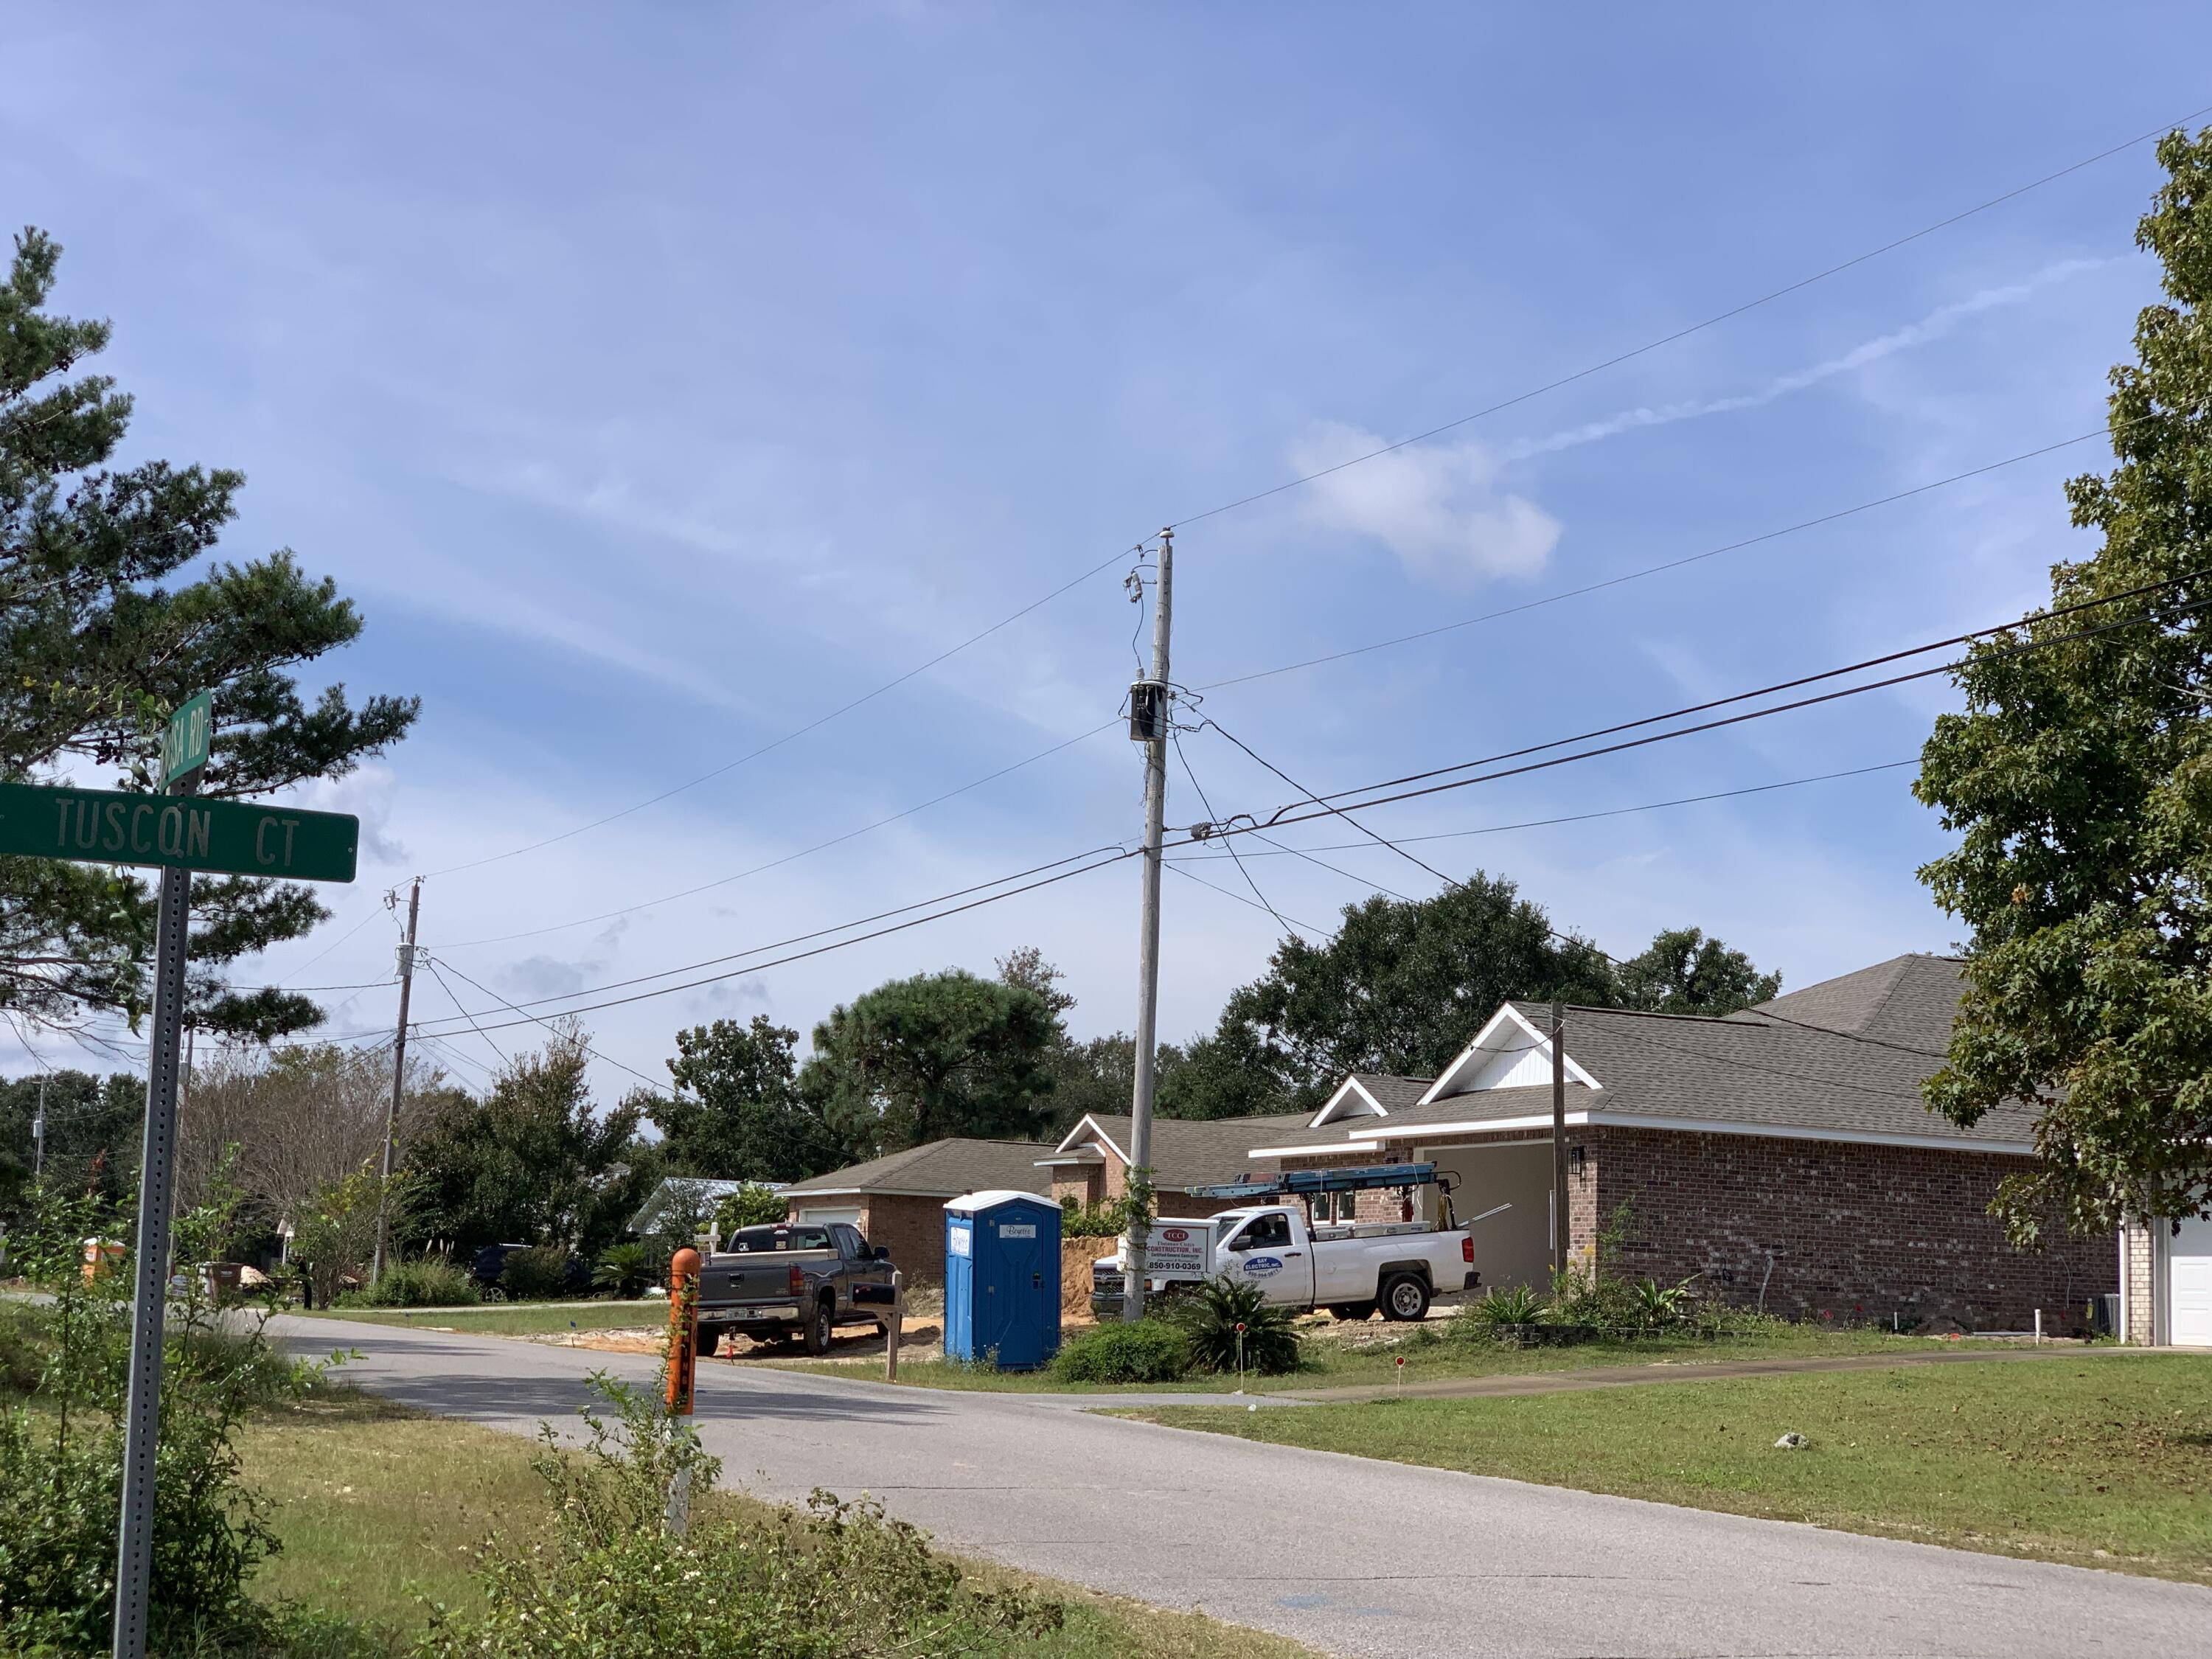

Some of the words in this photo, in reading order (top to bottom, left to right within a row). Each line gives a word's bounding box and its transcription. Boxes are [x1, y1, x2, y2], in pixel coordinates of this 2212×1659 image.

[188, 706, 204, 759] RD
[55, 798, 211, 858] TUSCON
[256, 815, 299, 867] CT
[1149, 1262, 1201, 1270] 850-910-0369
